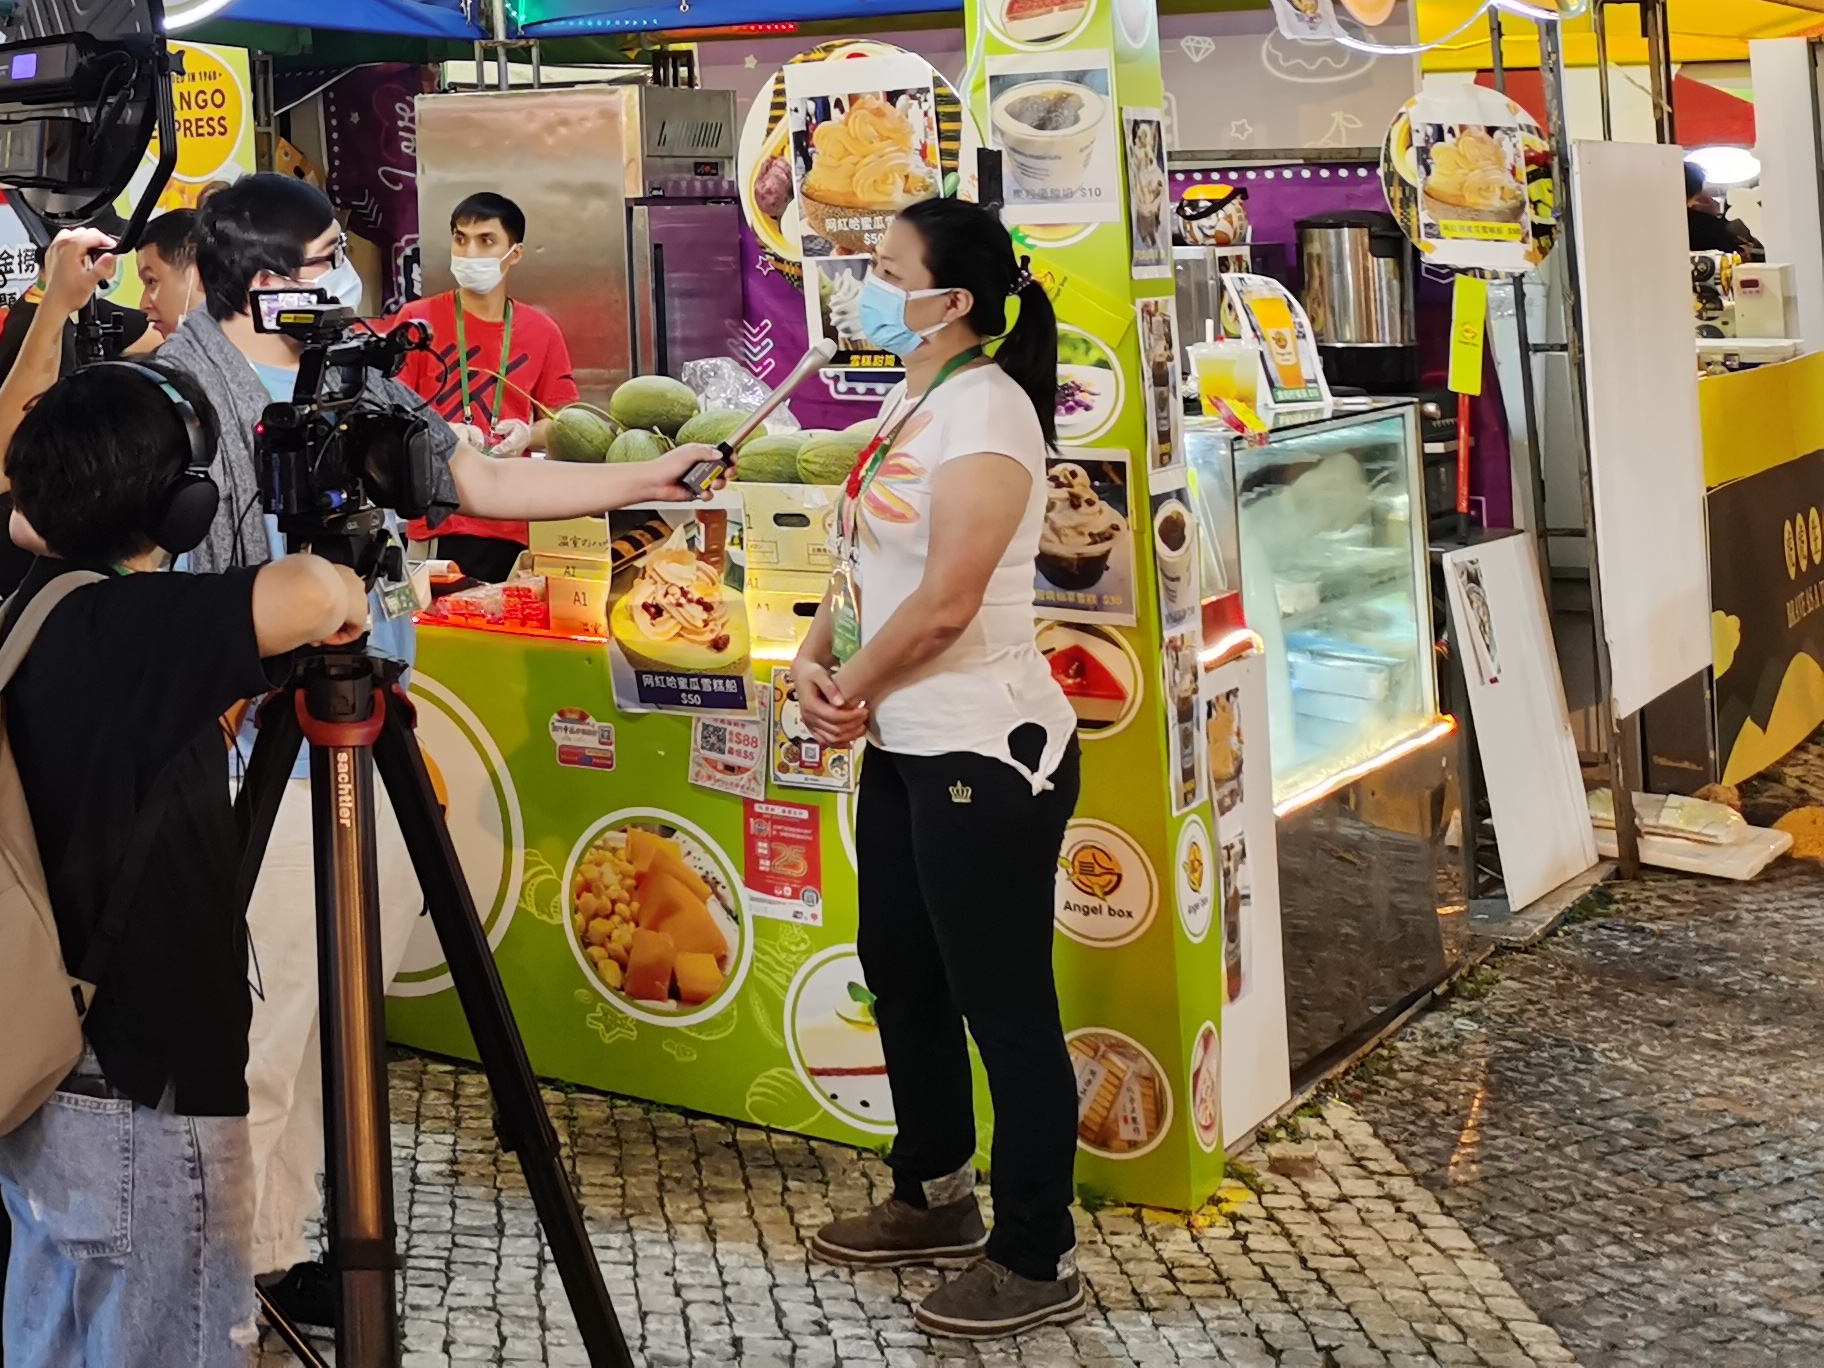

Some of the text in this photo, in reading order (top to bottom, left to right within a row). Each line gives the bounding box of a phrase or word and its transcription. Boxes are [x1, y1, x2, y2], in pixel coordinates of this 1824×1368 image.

[573, 591, 588, 607] A1
[680, 692, 702, 706] $50
[336, 751, 353, 829] sachtler
[1062, 899, 1135, 920] Angel box
